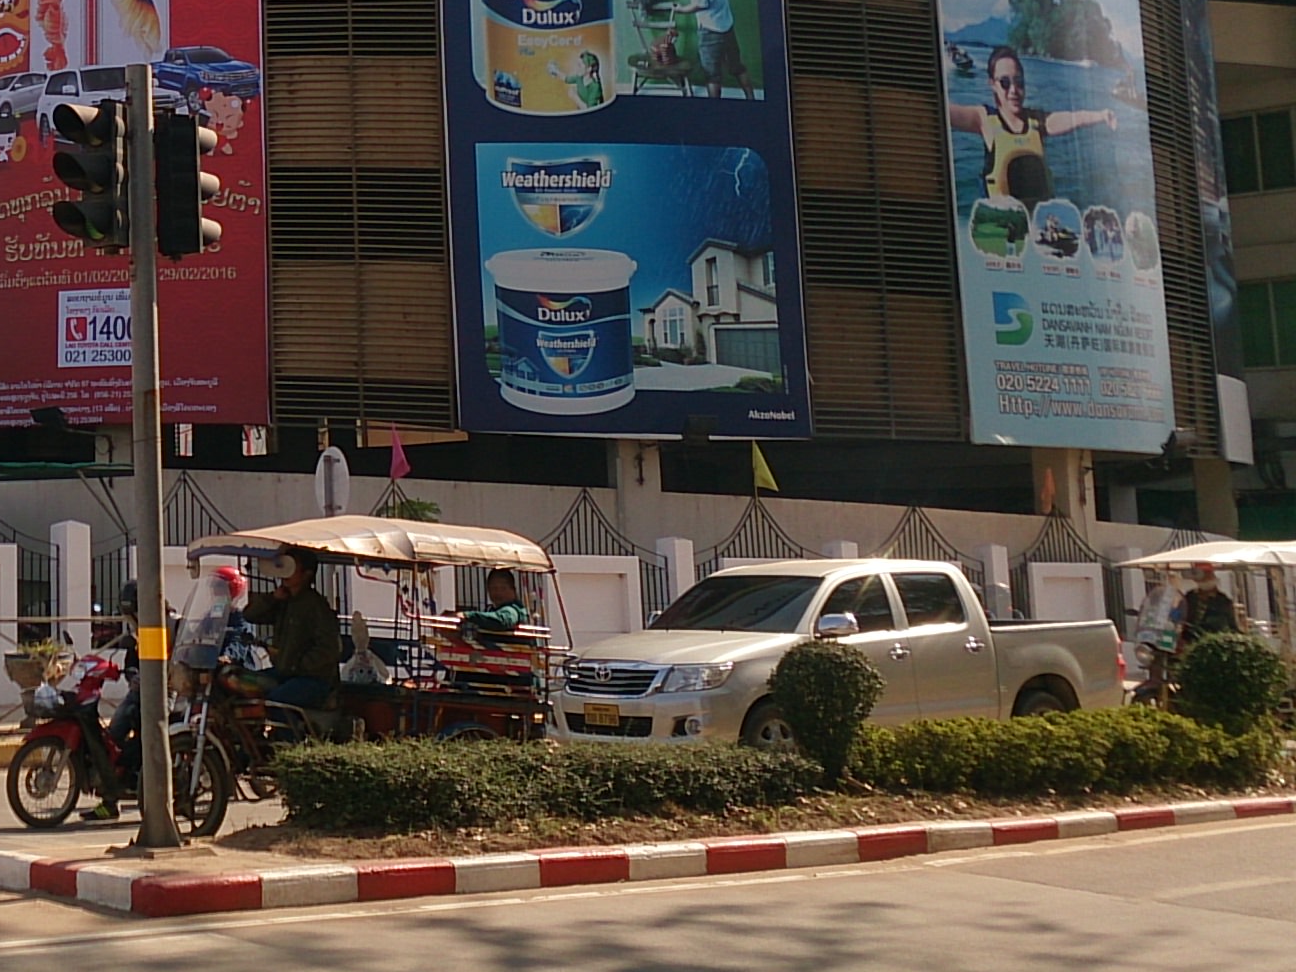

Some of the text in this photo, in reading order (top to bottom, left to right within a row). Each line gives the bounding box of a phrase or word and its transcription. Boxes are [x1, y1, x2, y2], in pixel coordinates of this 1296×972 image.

[522, 8, 575, 25] Dulux
[502, 169, 611, 188] Weathershield
[74, 269, 130, 285] 01/02/20
[159, 267, 237, 281] 29/02/2016
[537, 307, 585, 322] Dulux
[65, 349, 132, 362] 021 25300
[996, 374, 1023, 390] 020
[1026, 375, 1060, 393] 5224
[748, 409, 795, 421] AkzoNobel
